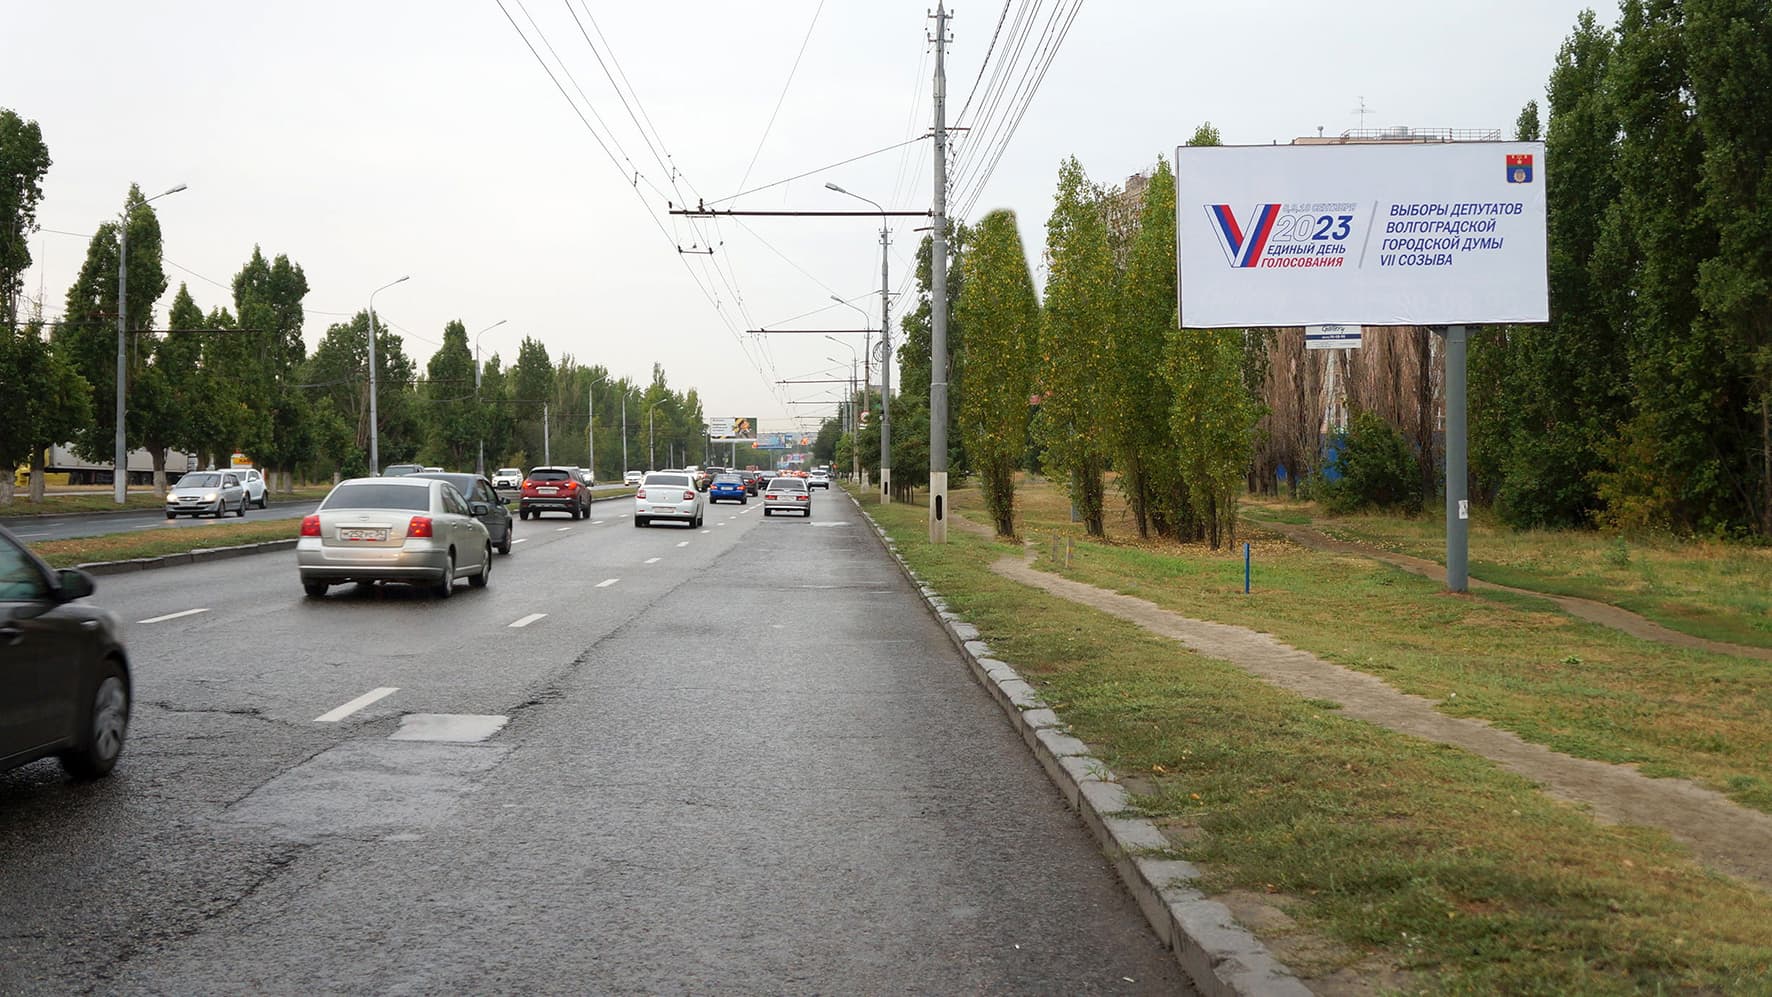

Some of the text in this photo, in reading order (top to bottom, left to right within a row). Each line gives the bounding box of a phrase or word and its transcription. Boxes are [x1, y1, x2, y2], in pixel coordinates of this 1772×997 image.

[1390, 203, 1523, 217] ВЫБОРЫ ДЕПУТАТОВ
[1271, 214, 1353, 242] 2023
[1386, 218, 1496, 234] ВОЛГОГРАДСКОЙ
[1267, 243, 1346, 256] ЕДИНЫЙ ДЕНЬ
[1382, 236, 1503, 252] ГОРОДСКОЙ ДУМЫ
[1261, 257, 1344, 268] ГОЛОСОВАНИЯ
[1380, 254, 1453, 266] VII СОЗЫВА
